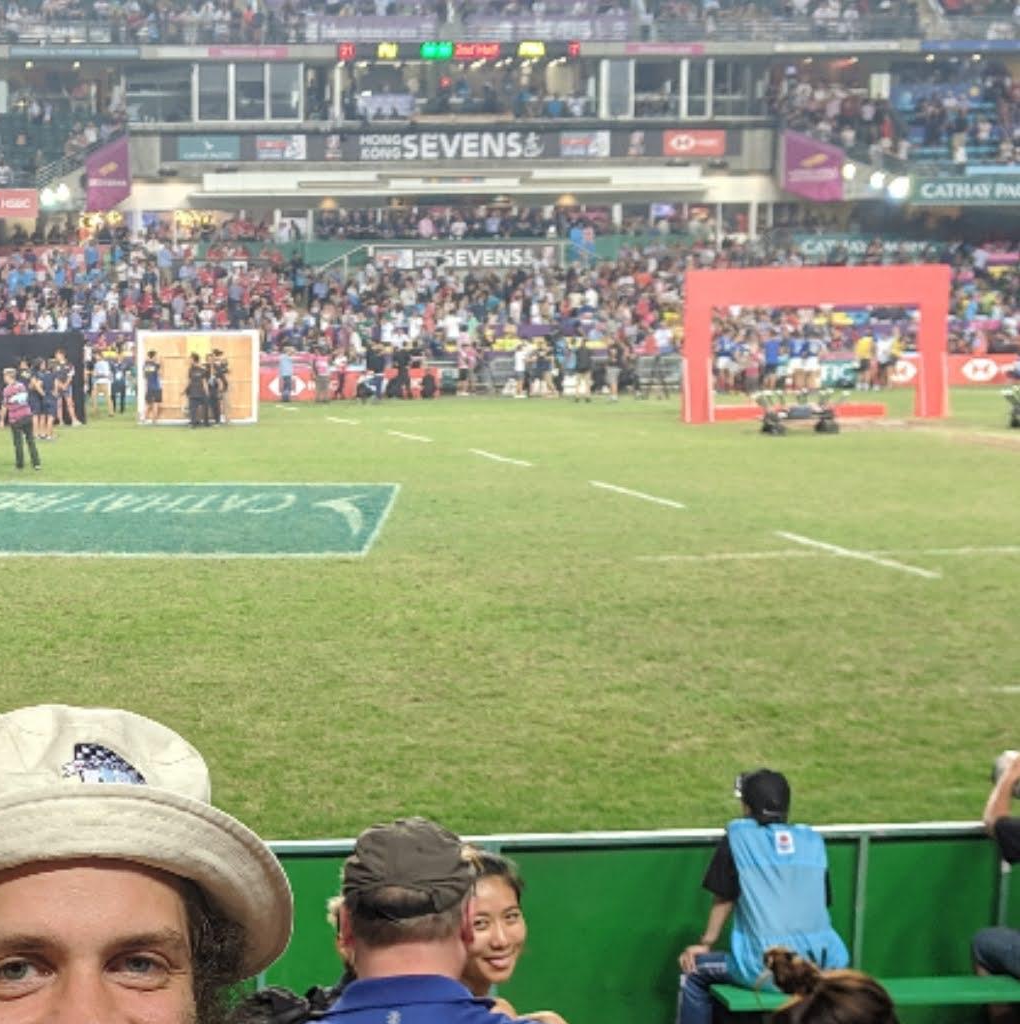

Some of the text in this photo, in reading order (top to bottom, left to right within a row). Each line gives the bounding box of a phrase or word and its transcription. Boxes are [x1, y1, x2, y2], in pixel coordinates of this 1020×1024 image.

[359, 134, 401, 145] HONG
[403, 132, 521, 159] SEVENS
[361, 147, 401, 159] KONG
[921, 183, 992, 199] CATHAY
[444, 250, 523, 267] SEVENS
